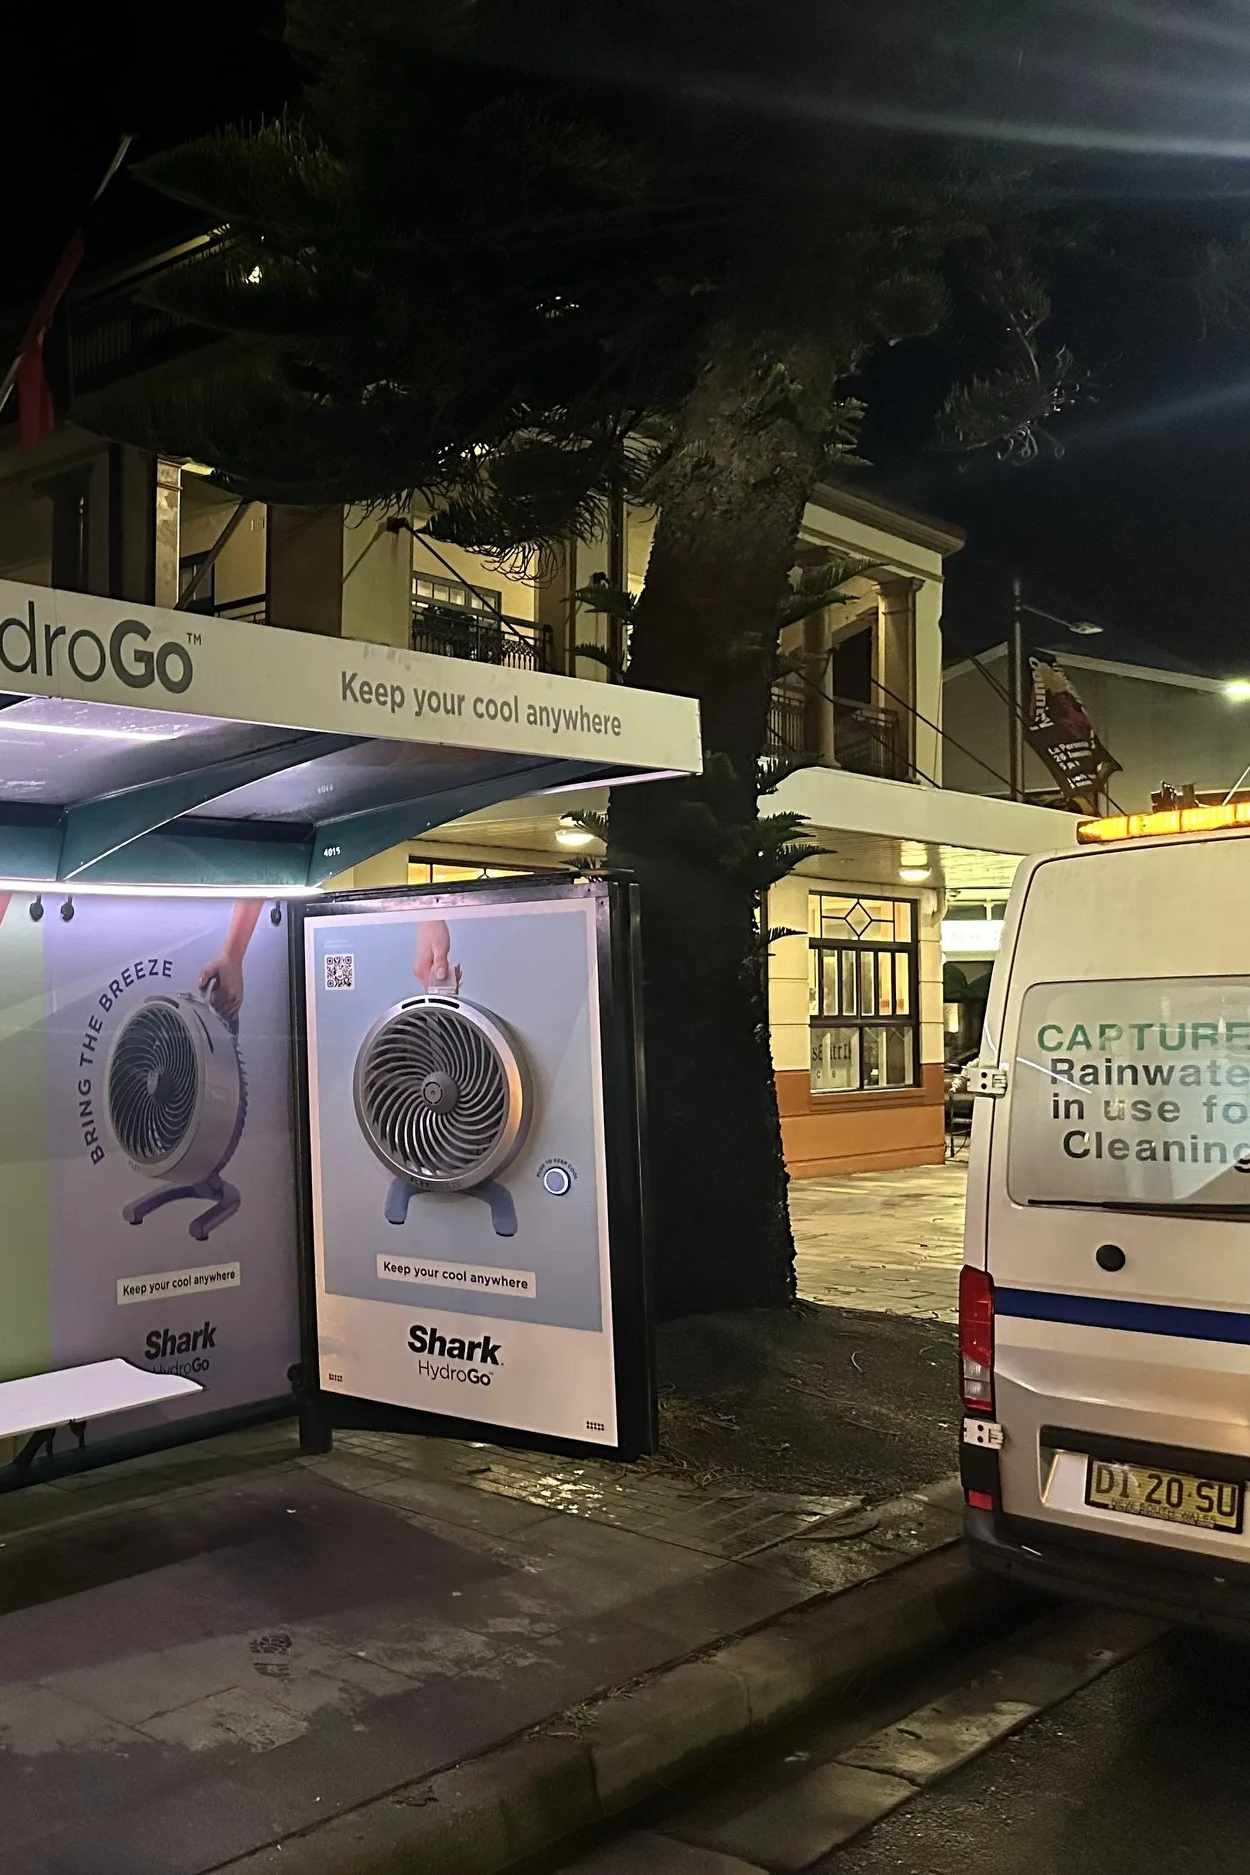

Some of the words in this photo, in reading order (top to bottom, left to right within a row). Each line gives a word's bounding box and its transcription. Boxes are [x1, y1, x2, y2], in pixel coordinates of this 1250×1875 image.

[341, 671, 405, 713] Keep
[413, 687, 465, 717] your
[472, 695, 519, 723] cool
[526, 703, 622, 736] anywhere
[323, 846, 341, 857] 4015
[98, 958, 174, 1012] BREEZE
[79, 1014, 104, 1067] THE
[78, 1079, 106, 1165] BRING
[1052, 1092, 1085, 1120] in
[1103, 1098, 1181, 1122] use
[123, 1284, 147, 1296] Keep
[149, 1280, 170, 1294] your
[172, 1275, 191, 1288] cool
[194, 1270, 235, 1286] anywhere
[383, 1261, 411, 1275] Keep
[414, 1266, 440, 1278] your
[442, 1271, 467, 1282] cool
[470, 1273, 528, 1289] anywhere
[144, 1321, 218, 1360] Shark
[407, 1324, 502, 1366] Shark
